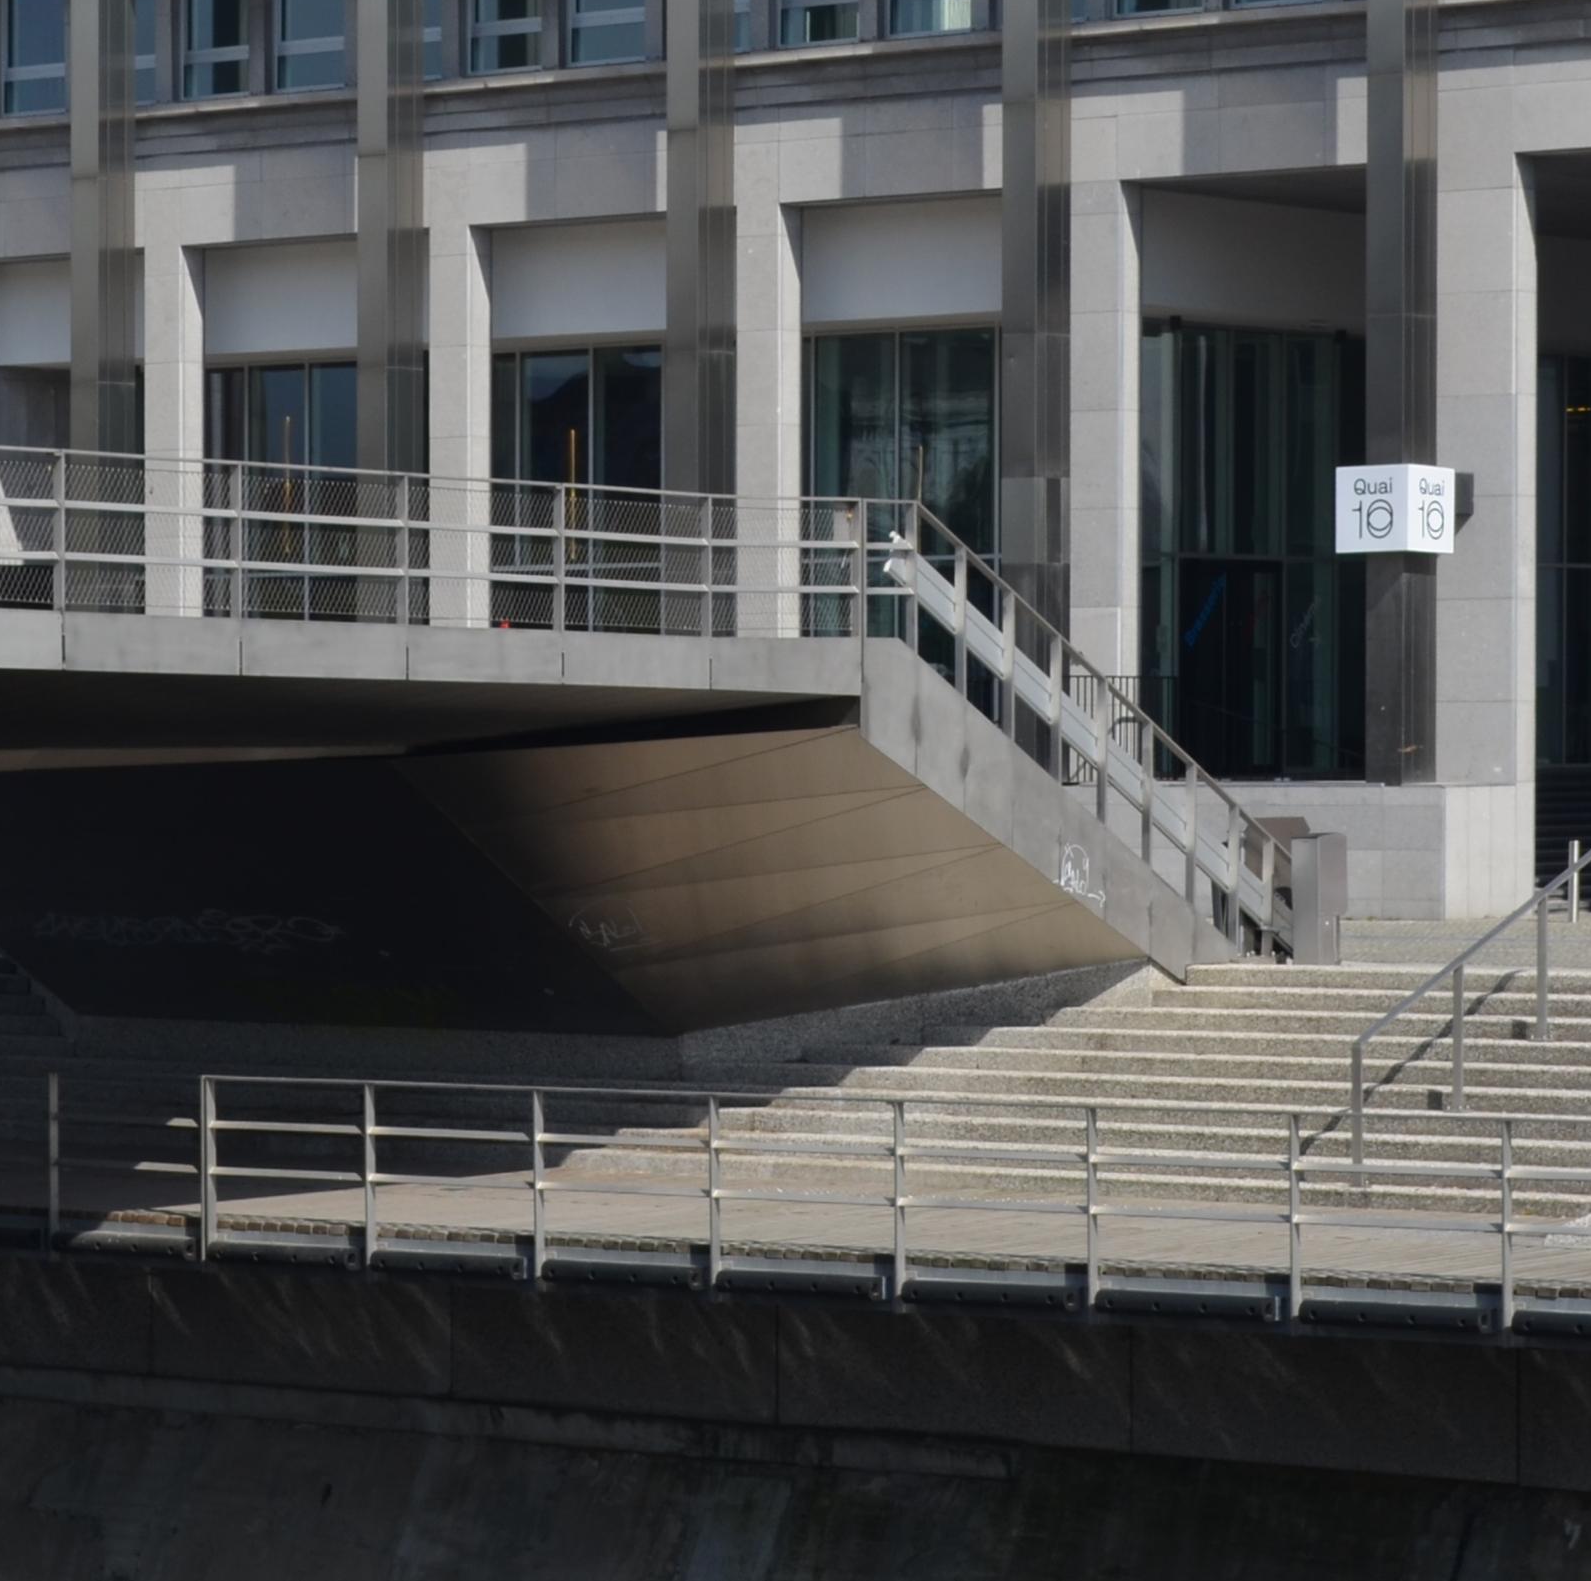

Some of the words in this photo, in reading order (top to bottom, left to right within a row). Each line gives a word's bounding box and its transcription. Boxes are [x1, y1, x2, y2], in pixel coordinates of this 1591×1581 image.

[1353, 476, 1393, 496] Quai
[1418, 477, 1446, 496] Quai
[1351, 498, 1394, 540] 10
[1417, 499, 1445, 541] 10
